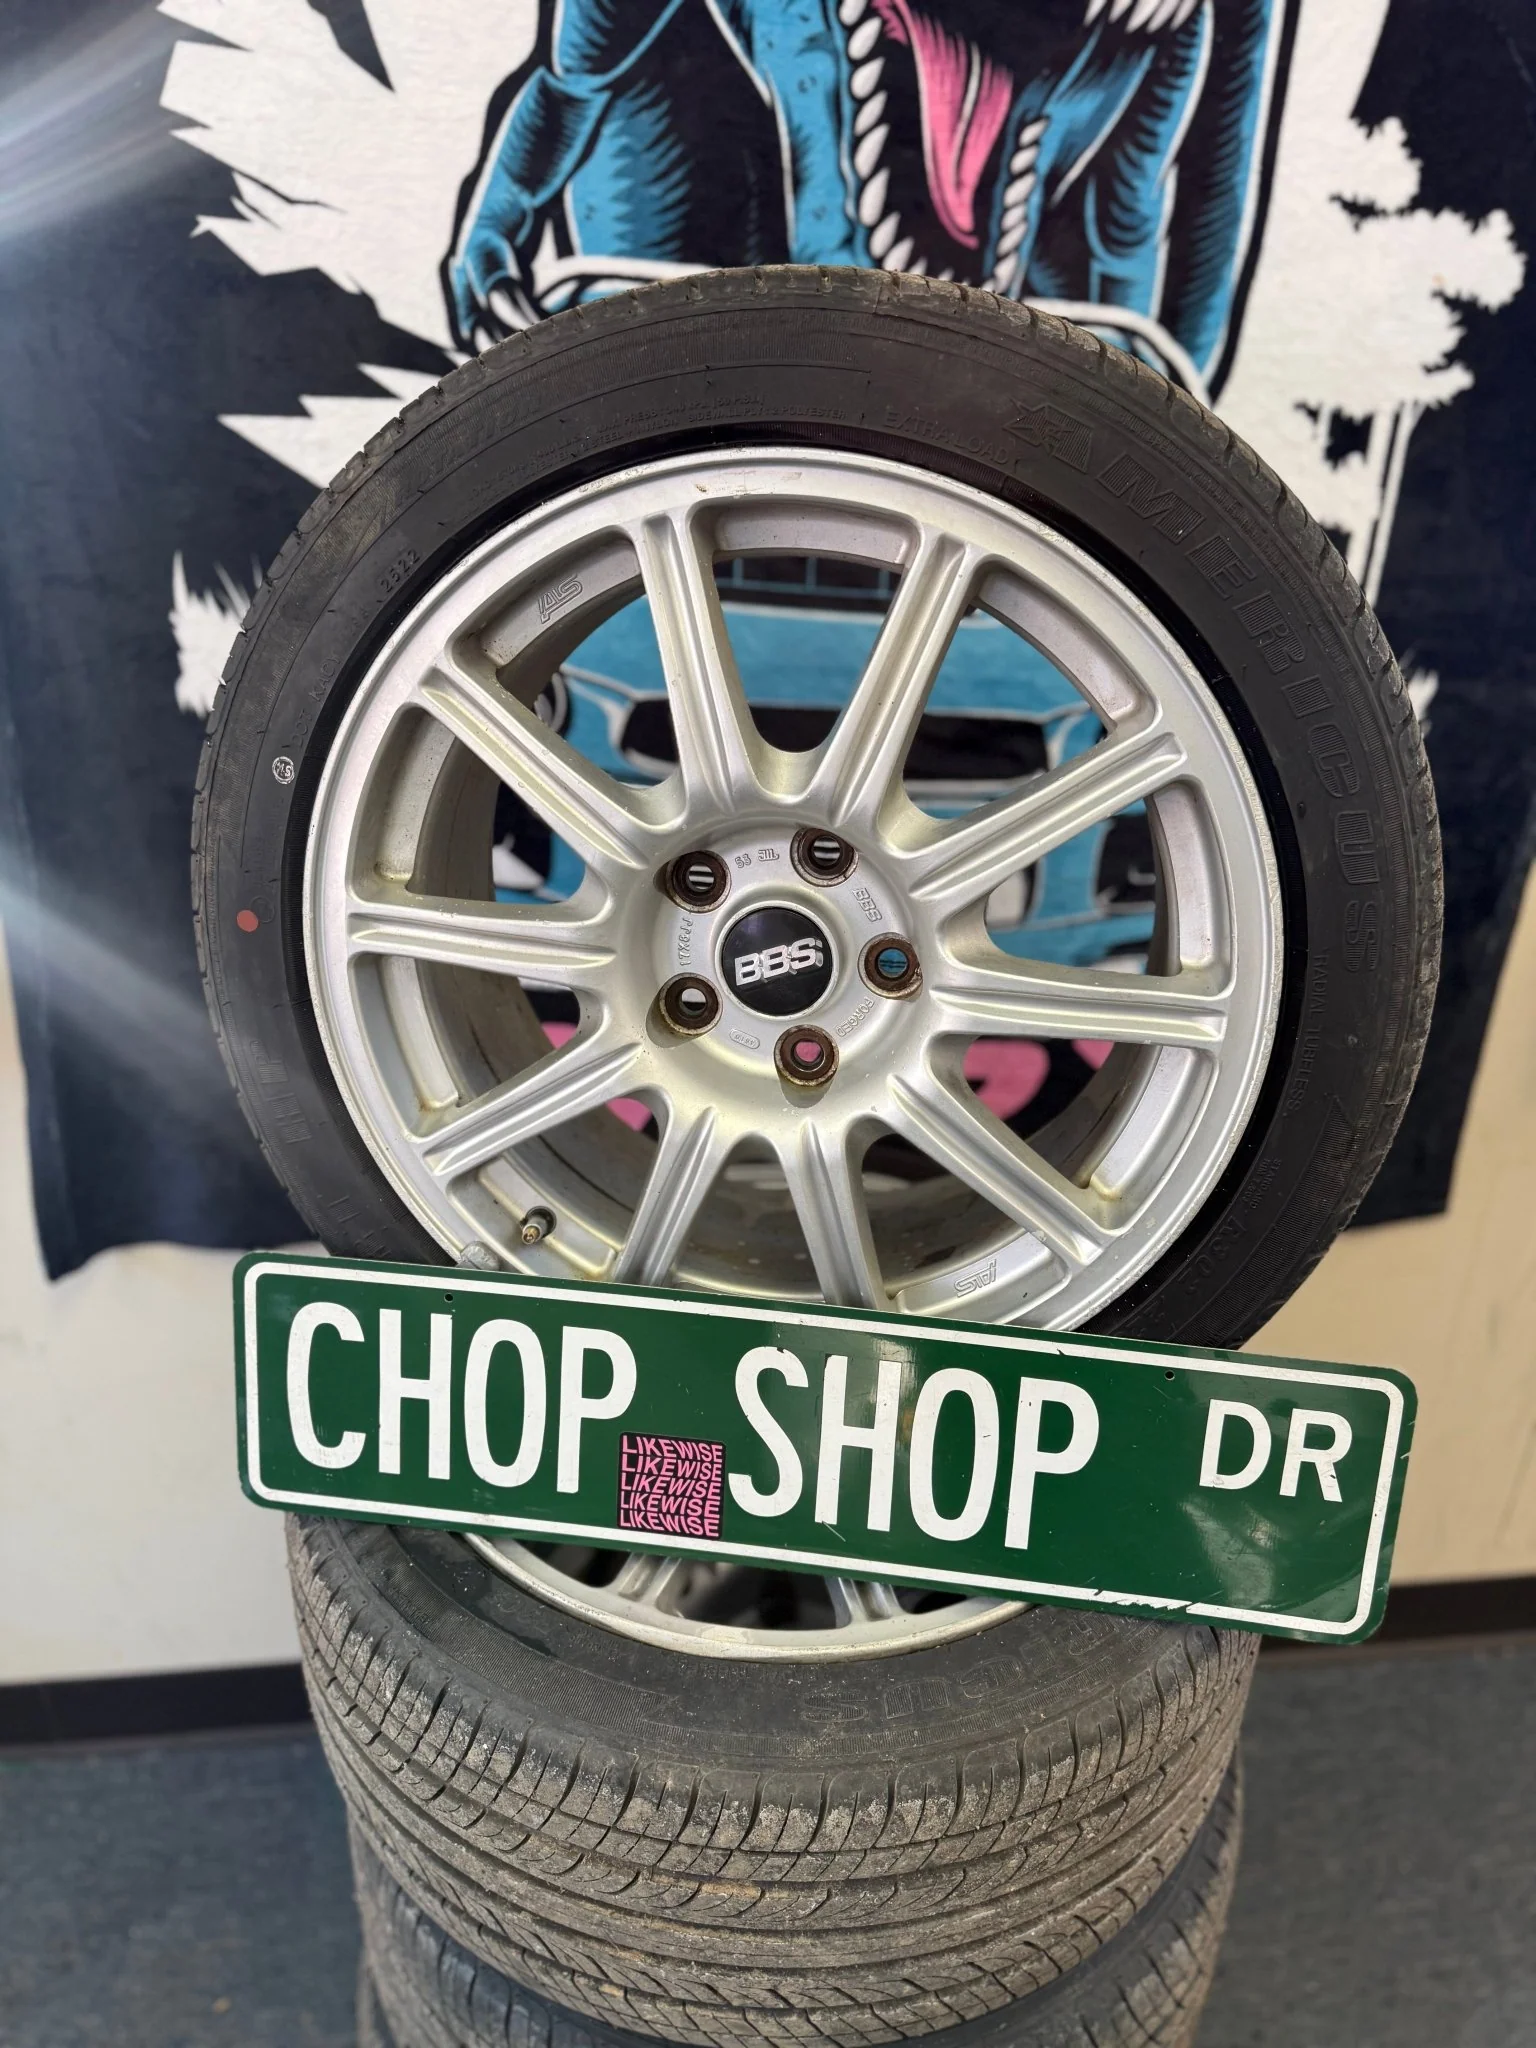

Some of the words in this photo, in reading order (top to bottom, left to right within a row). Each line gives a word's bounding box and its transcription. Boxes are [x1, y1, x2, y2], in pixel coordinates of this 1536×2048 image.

[379, 547, 422, 593] 2522
[1003, 397, 1384, 976] AMERICUS
[734, 852, 752, 869] 53
[852, 887, 883, 923] BBS
[734, 937, 824, 986] BBS
[835, 995, 876, 1038] FORGED
[287, 1301, 637, 1494] CHOP
[728, 1346, 1100, 1549] SHOP
[1199, 1399, 1353, 1503] DR
[622, 1435, 723, 1463] LIKEWISE
[622, 1454, 723, 1482] LIKEWISE
[621, 1473, 721, 1501] LIKEWISE
[620, 1492, 721, 1519] LIKEWISE
[620, 1509, 720, 1537] LIKEWISE
